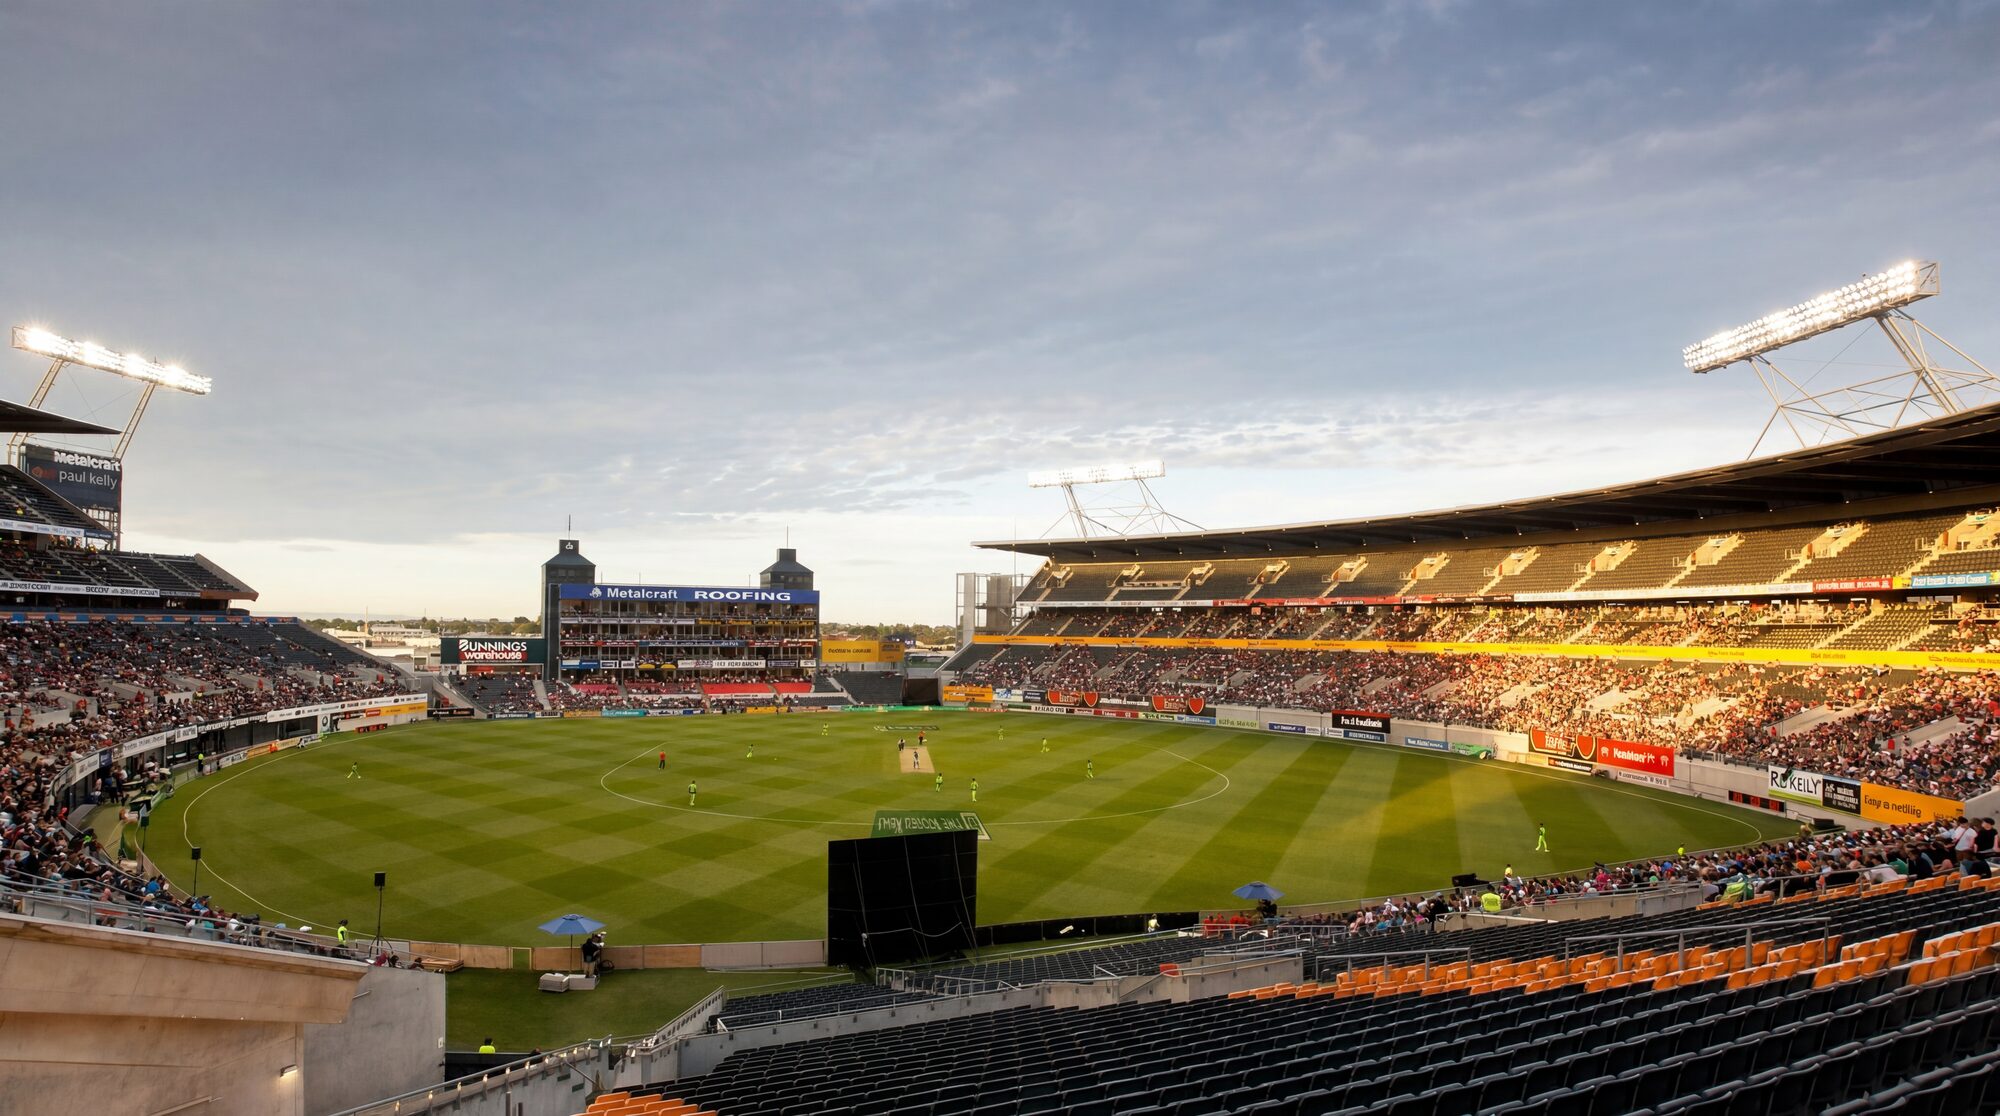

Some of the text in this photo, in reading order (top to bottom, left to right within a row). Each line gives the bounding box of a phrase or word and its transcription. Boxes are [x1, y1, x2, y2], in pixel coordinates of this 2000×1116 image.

[59, 471, 117, 490] paul kelly
[607, 587, 791, 601] Metalcraft ROOFING
[459, 639, 527, 651] BUNNINGS
[464, 650, 522, 660] warehouse
